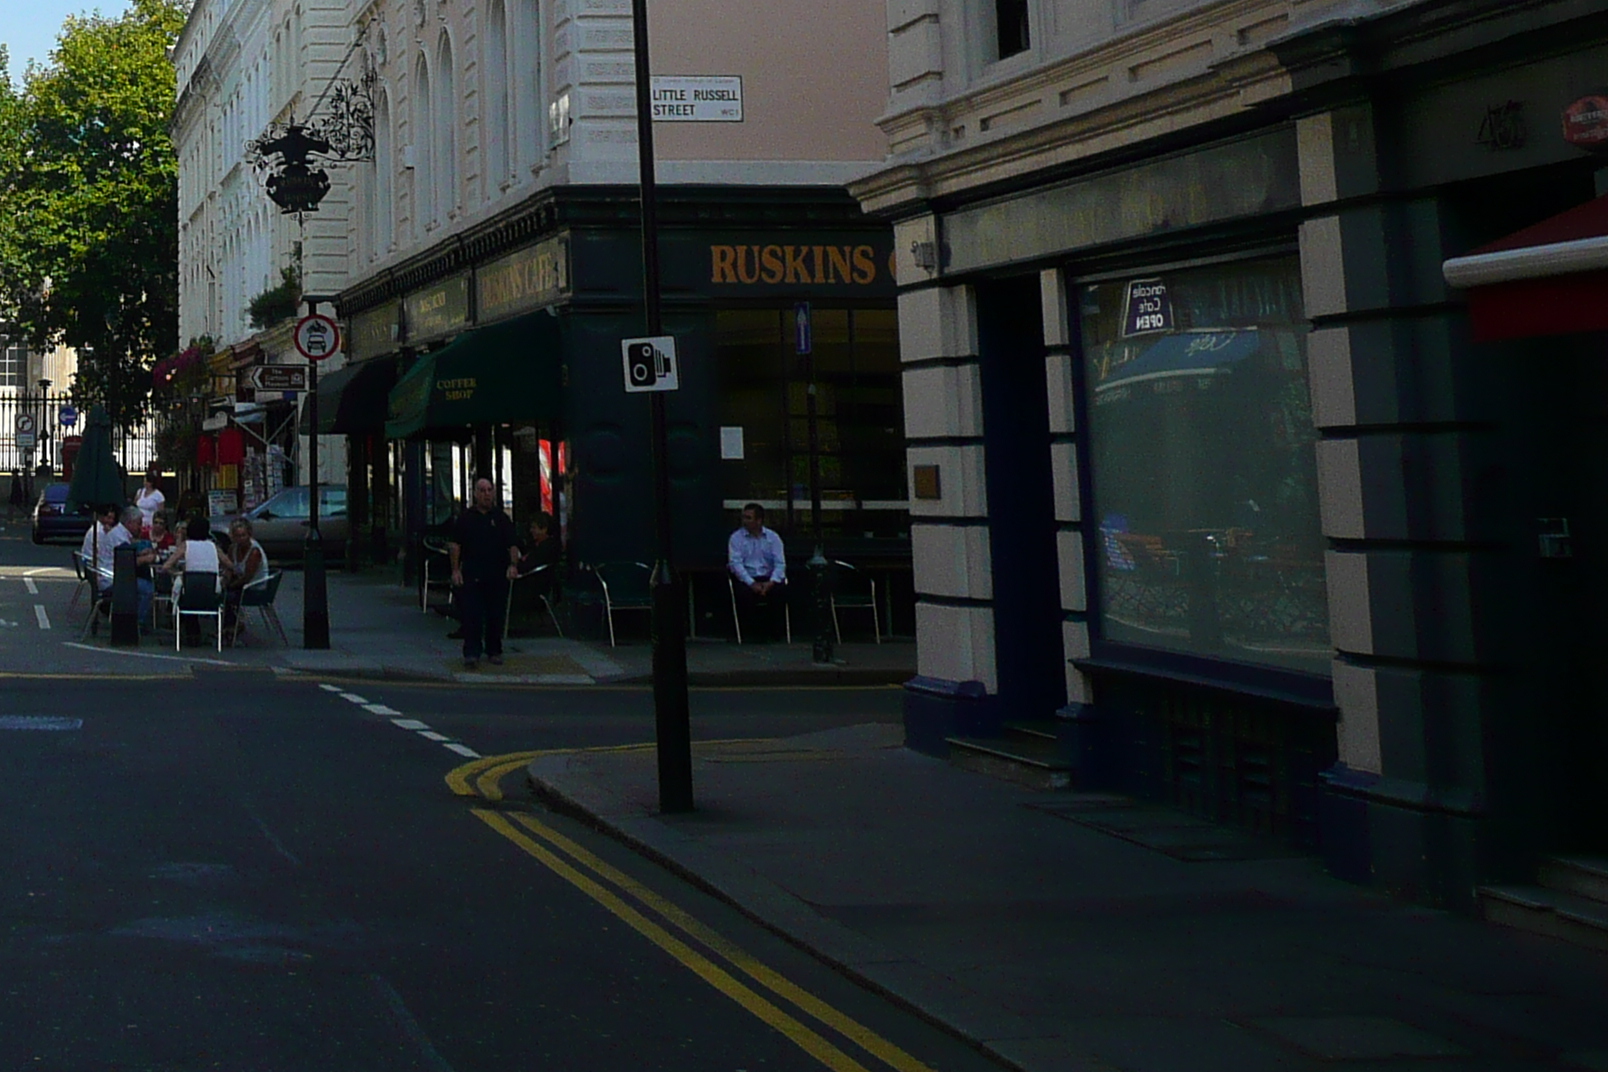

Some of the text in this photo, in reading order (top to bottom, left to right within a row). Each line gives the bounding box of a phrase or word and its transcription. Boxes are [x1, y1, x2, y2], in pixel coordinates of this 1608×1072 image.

[653, 89, 739, 101] LITTLE RUSSELL
[653, 104, 695, 116] STREET
[710, 244, 876, 284] RUSKINS
[436, 377, 478, 390] COFFEE
[445, 389, 474, 401] SHOP
